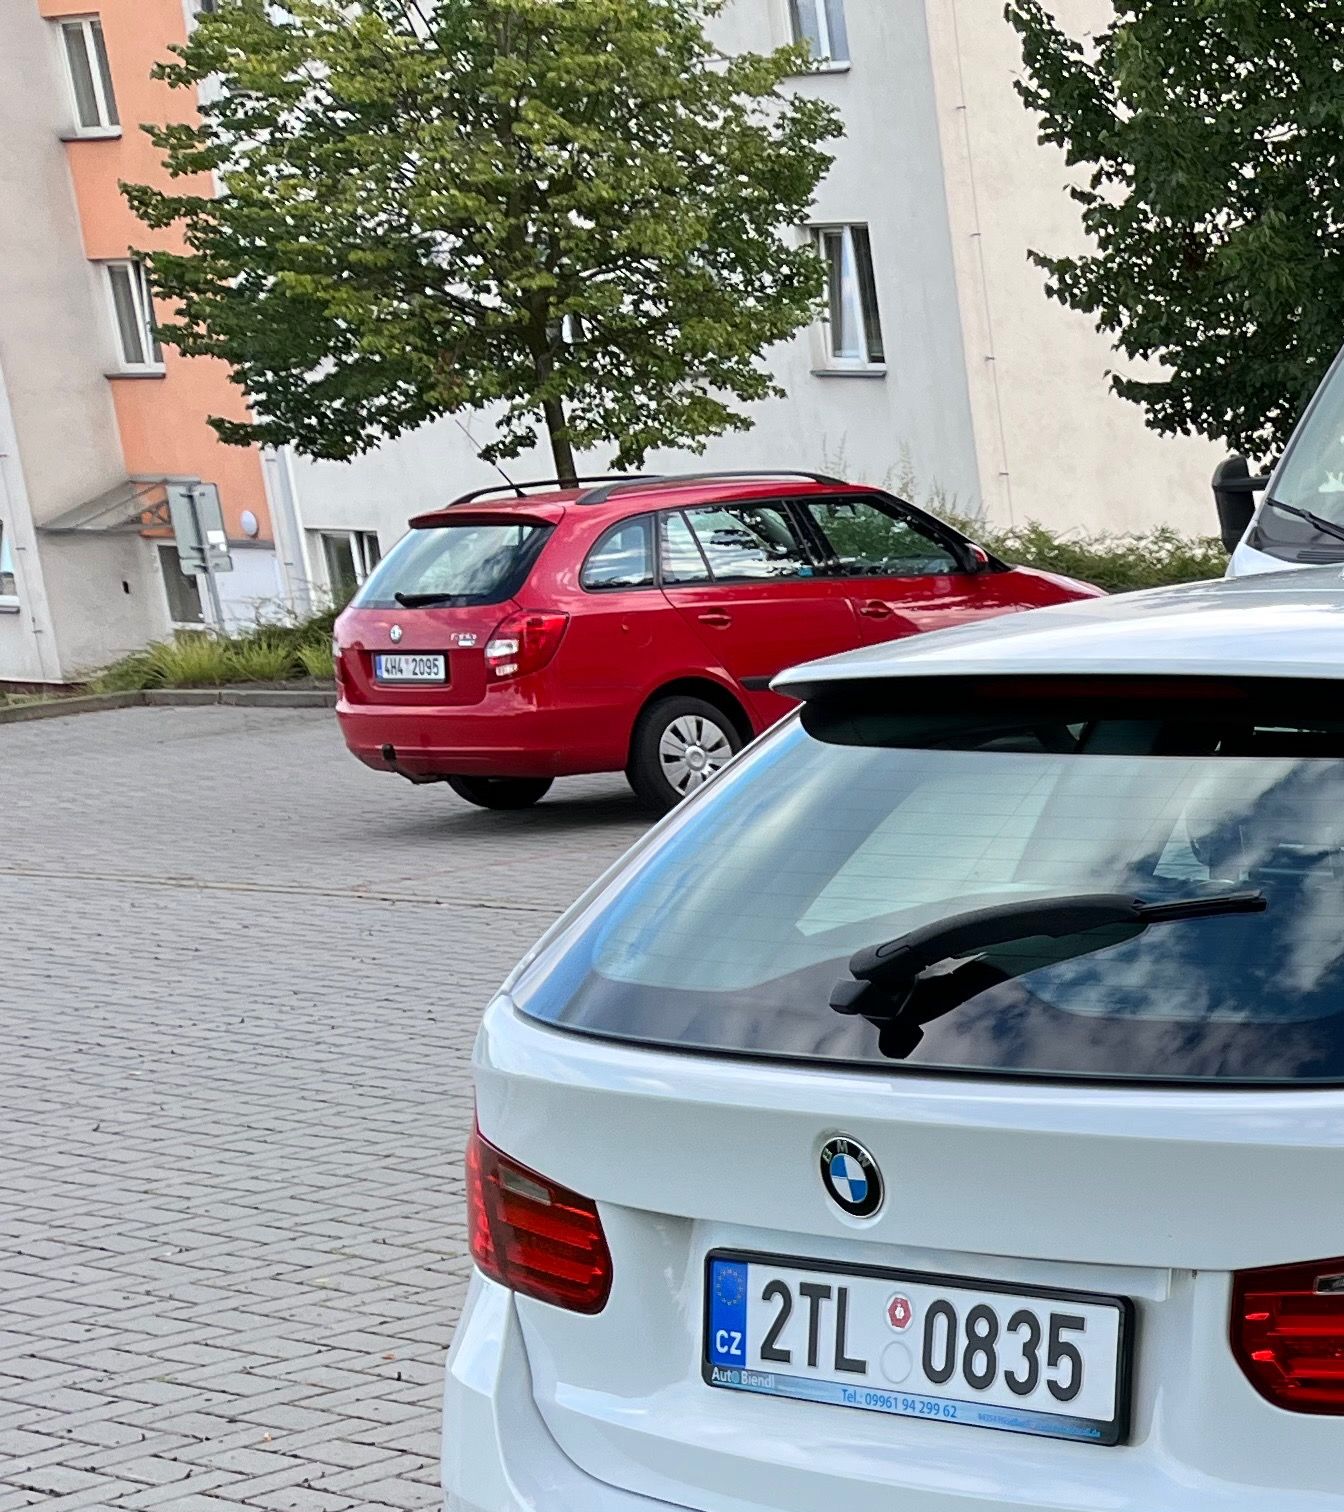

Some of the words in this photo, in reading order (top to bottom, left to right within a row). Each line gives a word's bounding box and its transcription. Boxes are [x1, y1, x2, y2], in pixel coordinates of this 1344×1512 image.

[384, 657, 403, 675] 4H4
[412, 657, 439, 675] 2095
[822, 1139, 871, 1166] BMW
[716, 1330, 742, 1355] CZ
[760, 1279, 867, 1374] 2TL
[922, 1299, 1086, 1402] 0835
[712, 1367, 739, 1383] Auto
[741, 1371, 775, 1388] Biendl
[865, 1393, 898, 1410] 09961
[902, 1398, 916, 1412] 94
[919, 1401, 940, 1416] 299
[943, 1405, 957, 1418] 62
